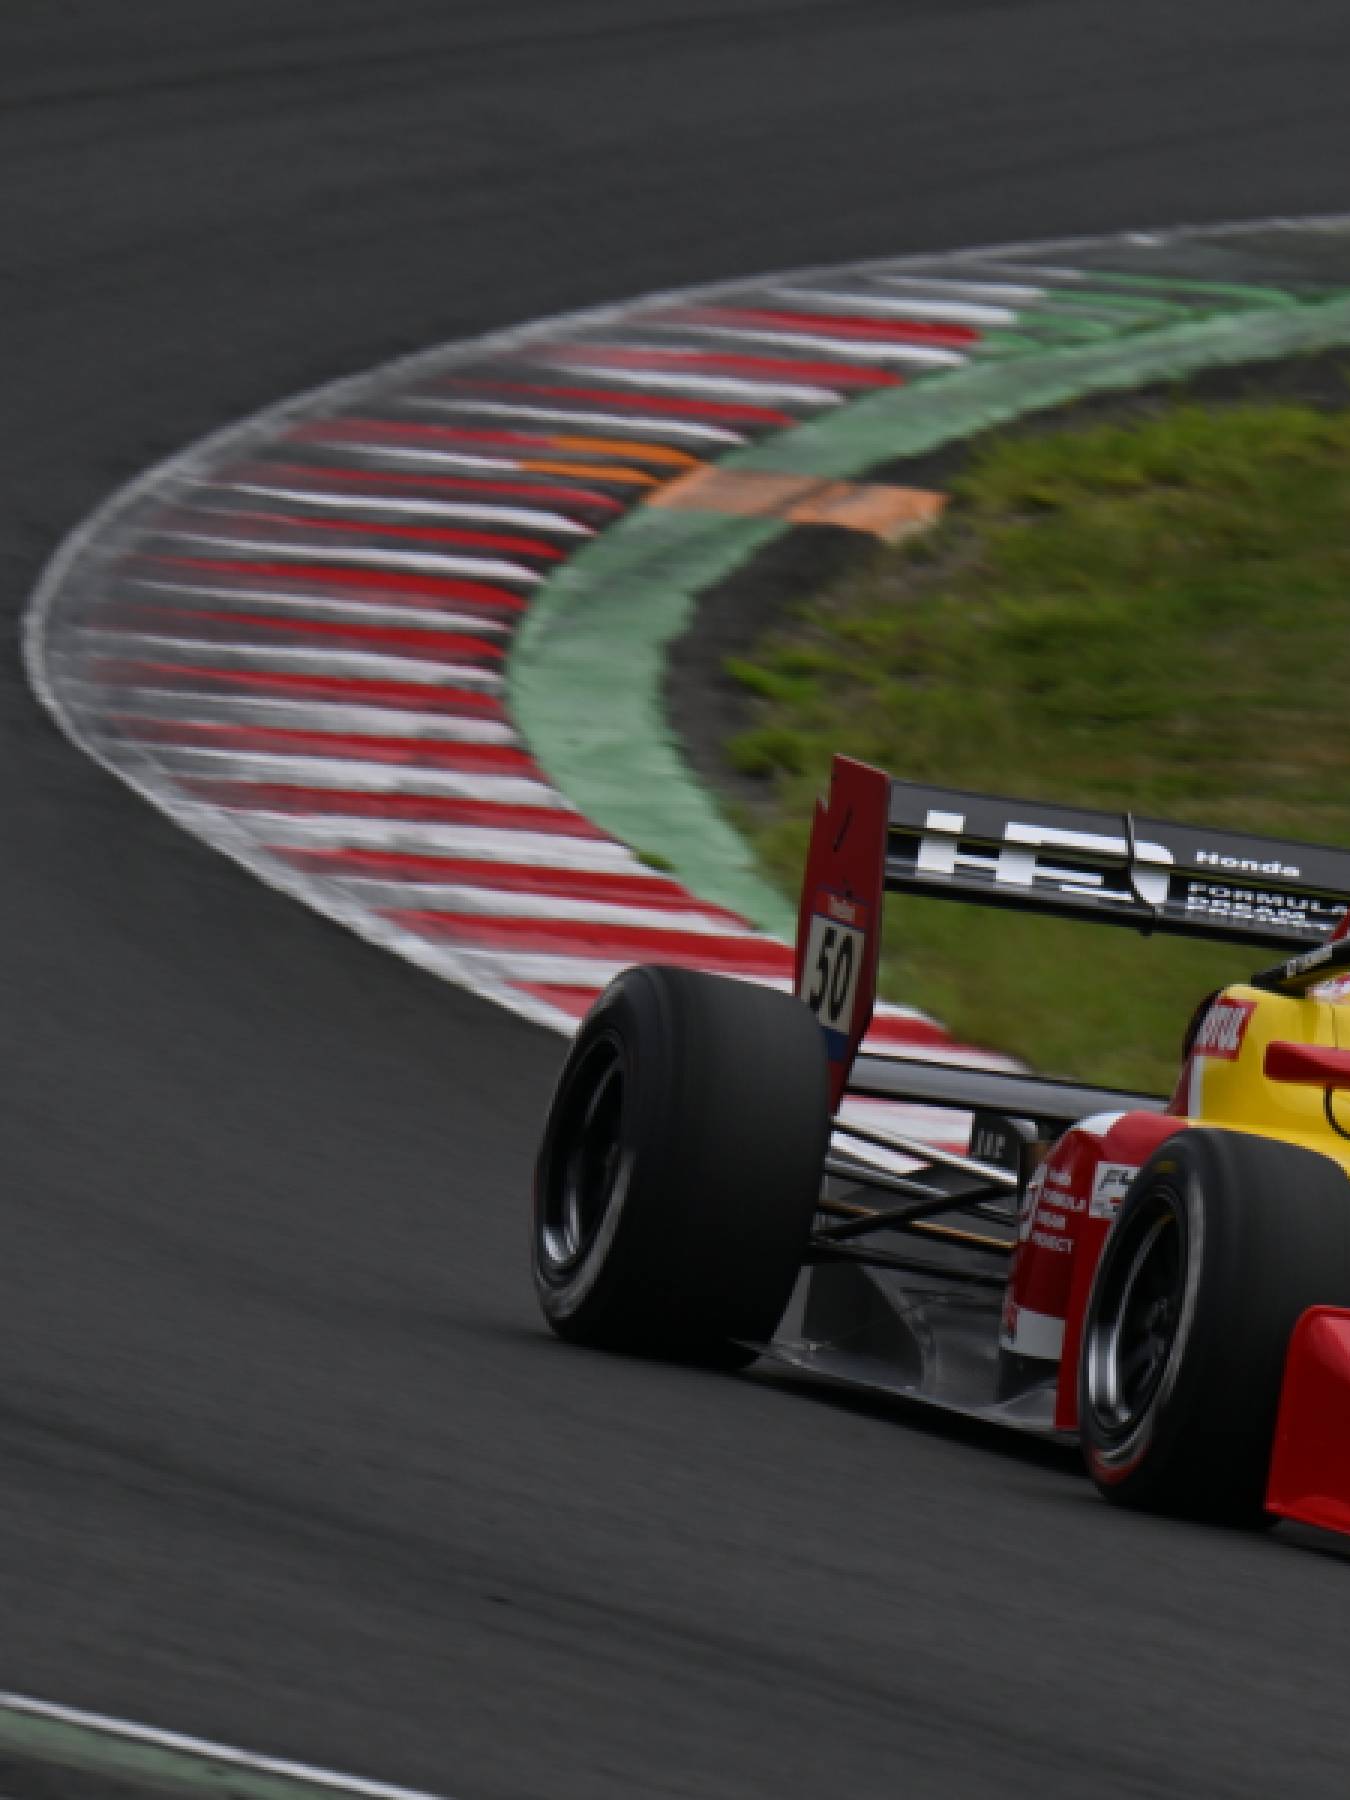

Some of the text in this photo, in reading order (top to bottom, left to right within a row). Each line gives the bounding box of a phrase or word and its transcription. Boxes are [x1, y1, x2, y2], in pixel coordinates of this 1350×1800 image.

[1196, 850, 1301, 877] Honda
[1187, 882, 1349, 914] FORMULA
[808, 926, 853, 1021] 50
